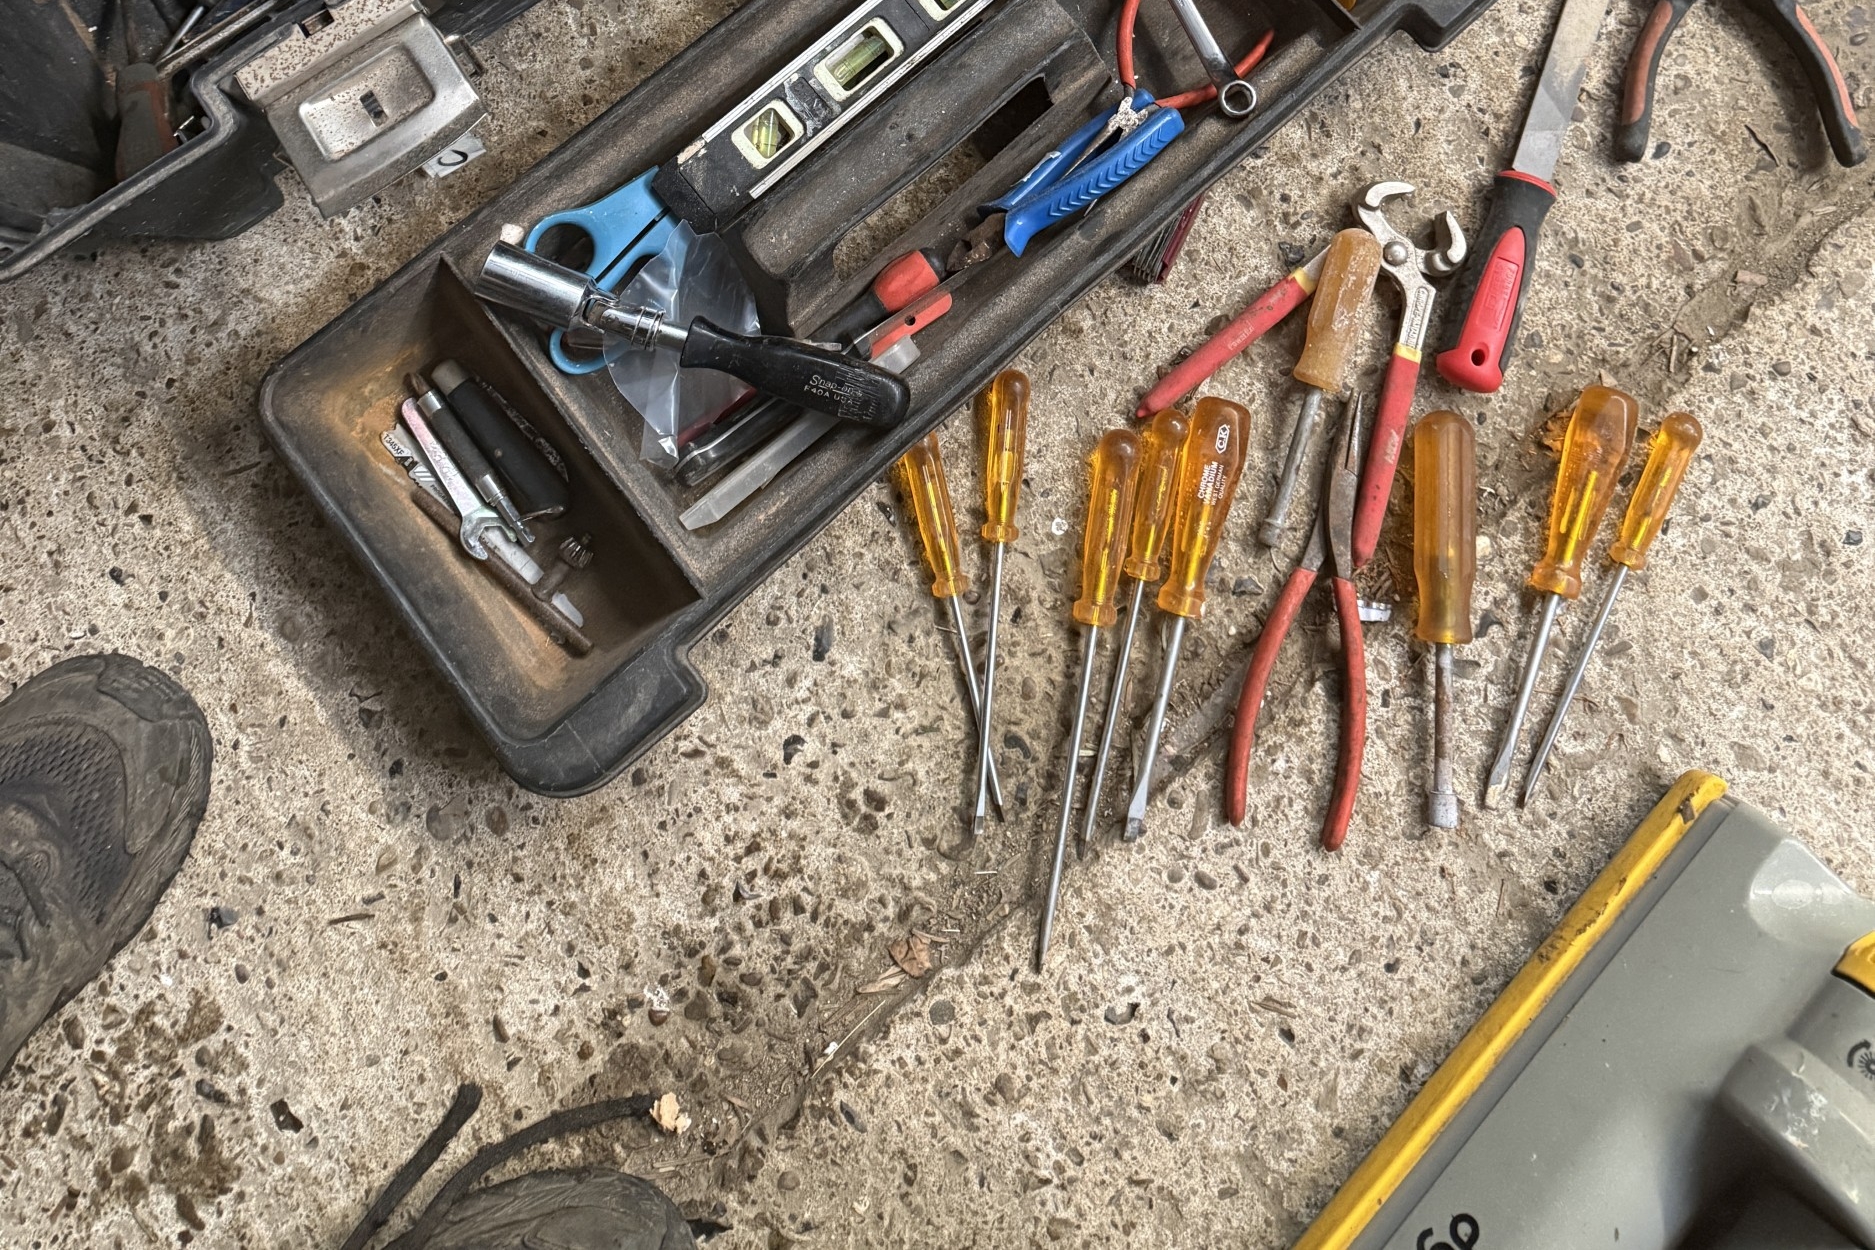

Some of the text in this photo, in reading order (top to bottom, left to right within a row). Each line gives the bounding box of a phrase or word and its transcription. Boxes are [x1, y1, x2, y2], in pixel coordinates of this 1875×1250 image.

[803, 385, 853, 405] F40A USA
[809, 374, 855, 396] Snap-on
[383, 433, 404, 456] T345XF
[1197, 464, 1211, 499] CHROME
[1202, 461, 1219, 505] VANADIUM
[1211, 464, 1224, 505] WEST GERMAN
[1217, 475, 1227, 499] QUALITY
